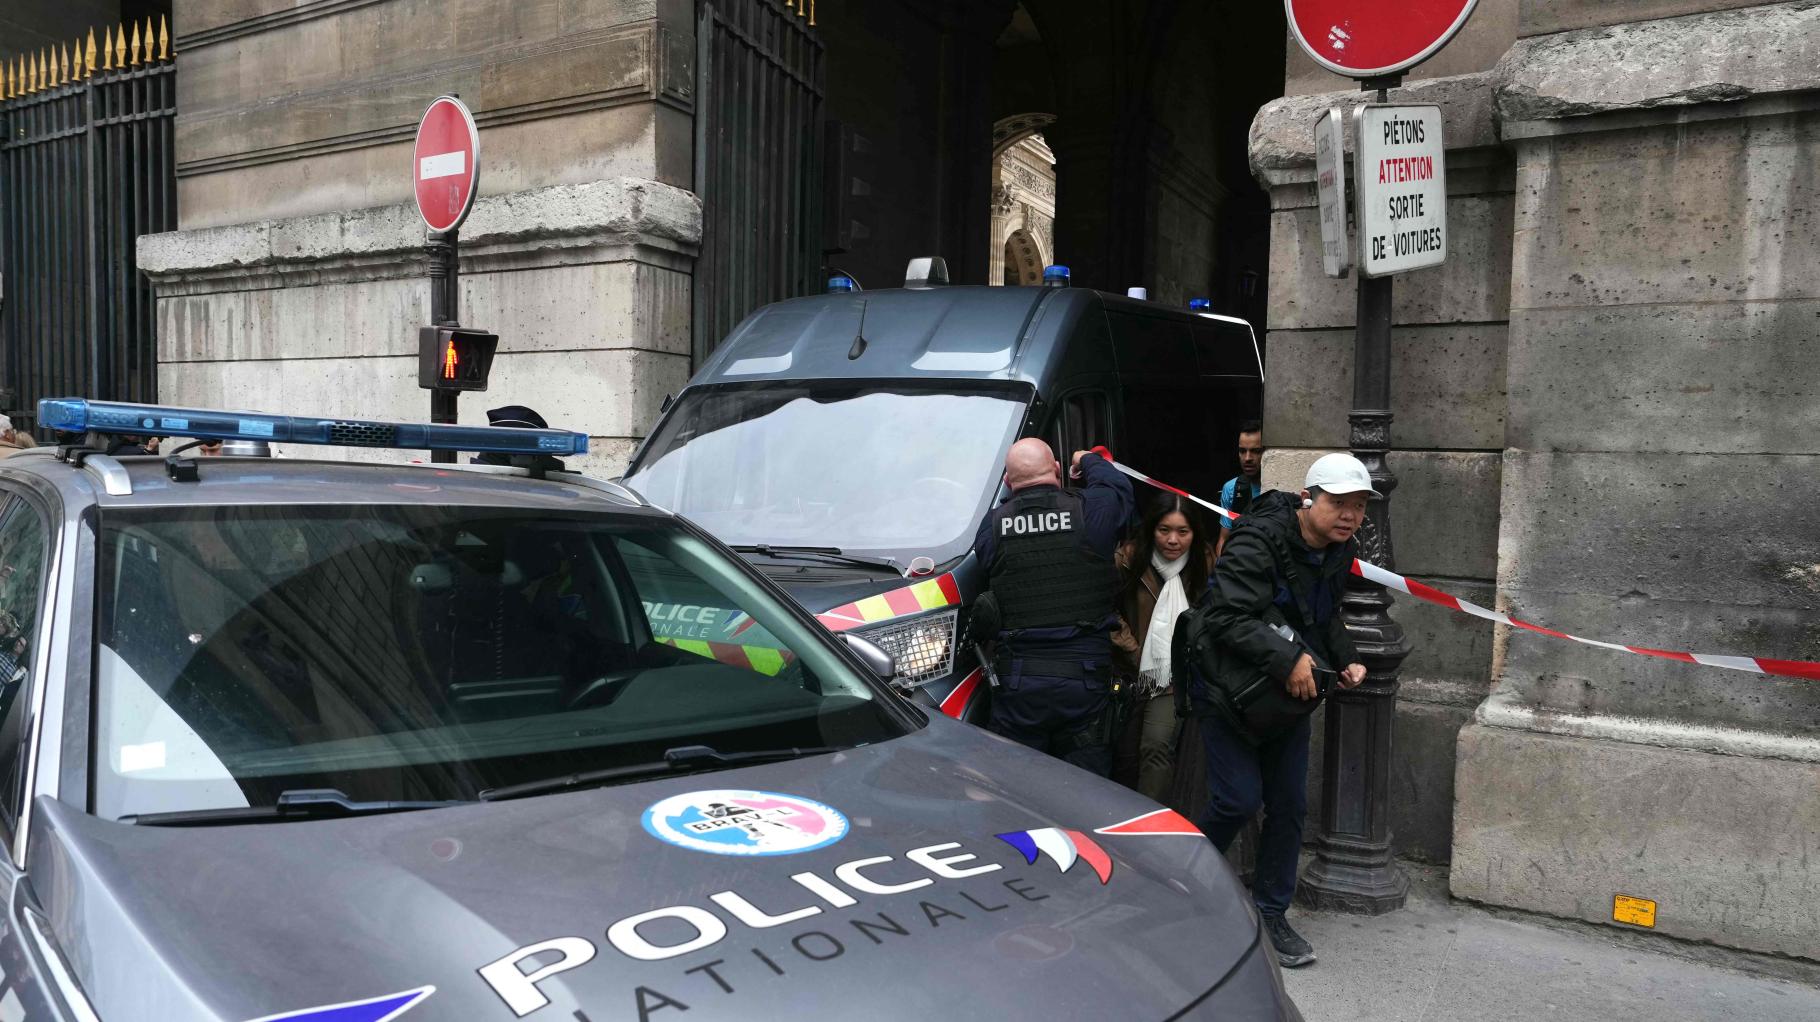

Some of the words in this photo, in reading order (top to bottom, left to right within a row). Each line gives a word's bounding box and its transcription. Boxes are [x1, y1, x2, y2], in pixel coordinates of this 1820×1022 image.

[1383, 114, 1425, 146] PIÉTONS
[1379, 156, 1433, 184] ATTENTION
[1389, 193, 1424, 220] SORTIE
[1372, 235, 1386, 261] DE
[1393, 227, 1442, 257] VOITURES
[1001, 511, 1072, 535] POLICE
[641, 601, 720, 624] LICE
[649, 623, 712, 638] ONALE
[692, 809, 794, 832] BRAV-L
[476, 841, 1005, 1018] POLICE
[573, 878, 1051, 1022] ATIONALE
